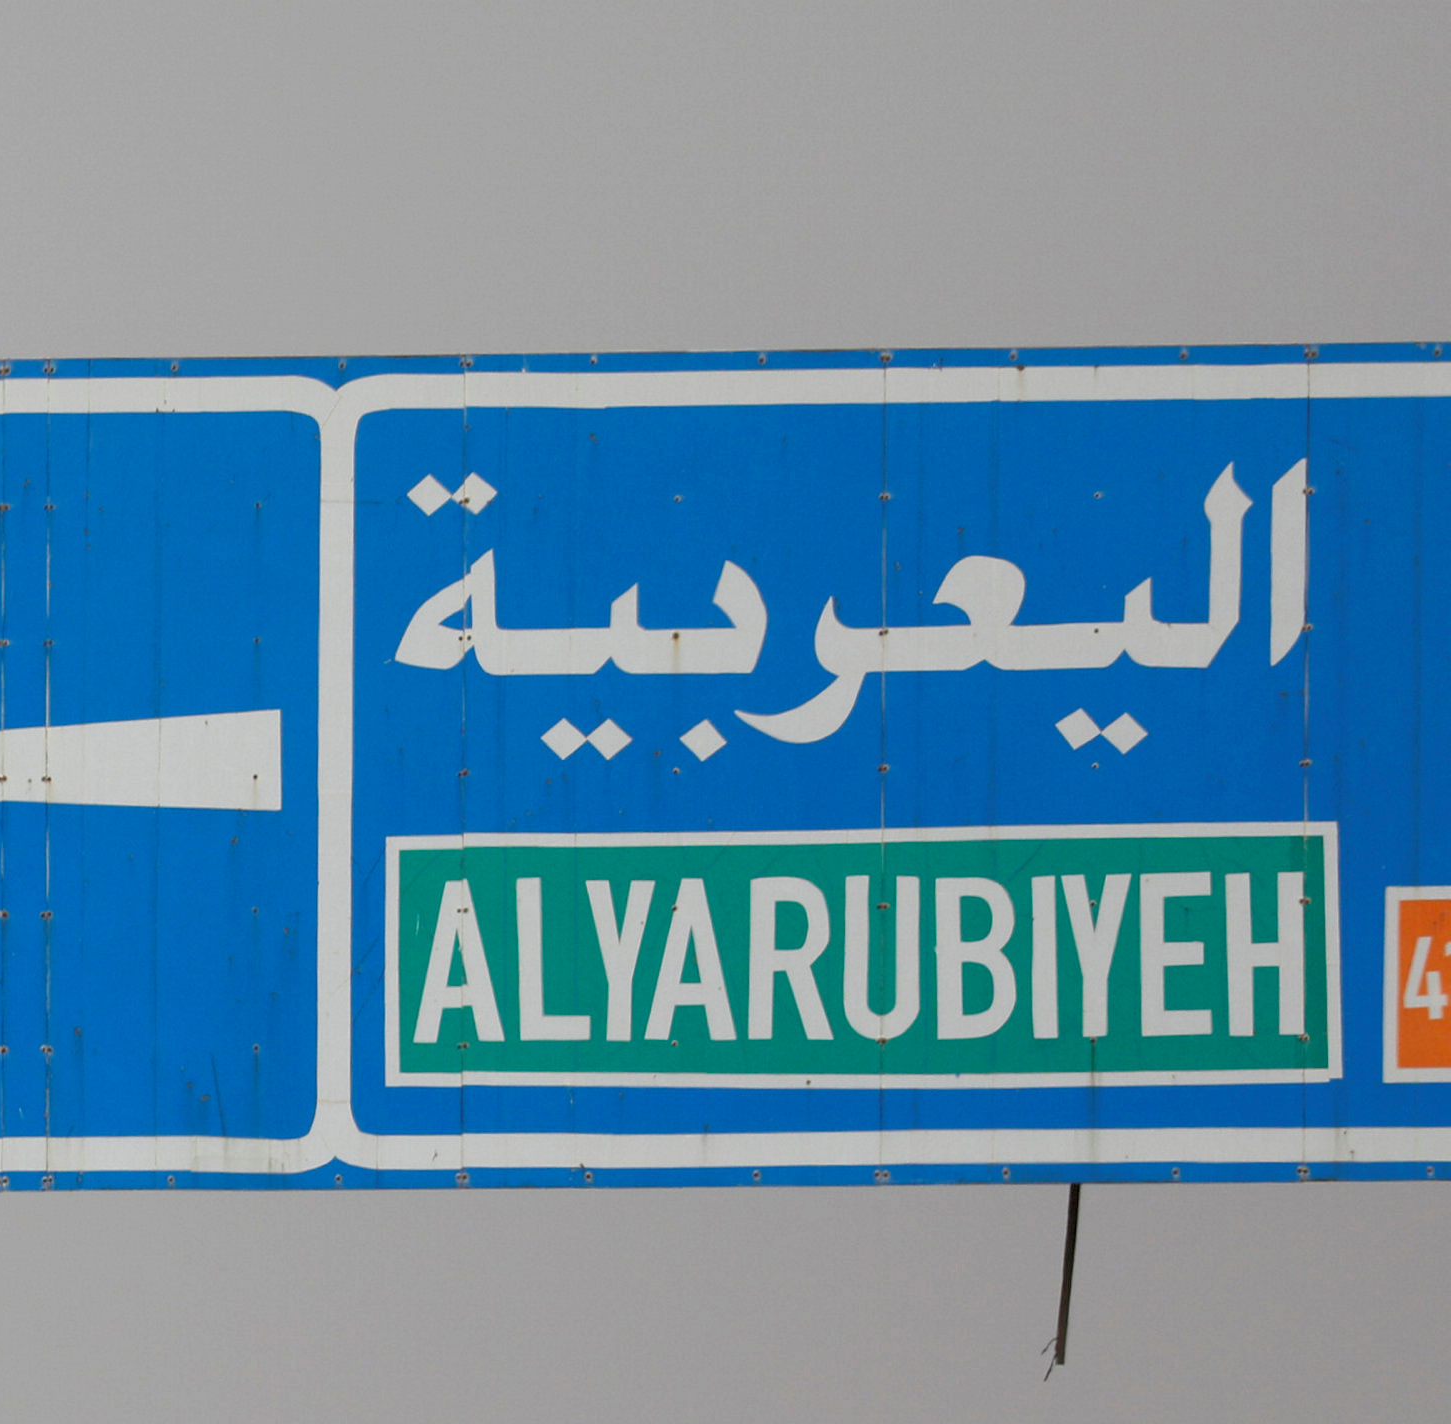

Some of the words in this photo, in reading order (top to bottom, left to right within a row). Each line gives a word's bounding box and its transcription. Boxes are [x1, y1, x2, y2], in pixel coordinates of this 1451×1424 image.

[395, 458, 1307, 761] اليعربية
[413, 871, 1305, 1043] ALYARUBIYEH
[1403, 936, 1451, 1020] 4
